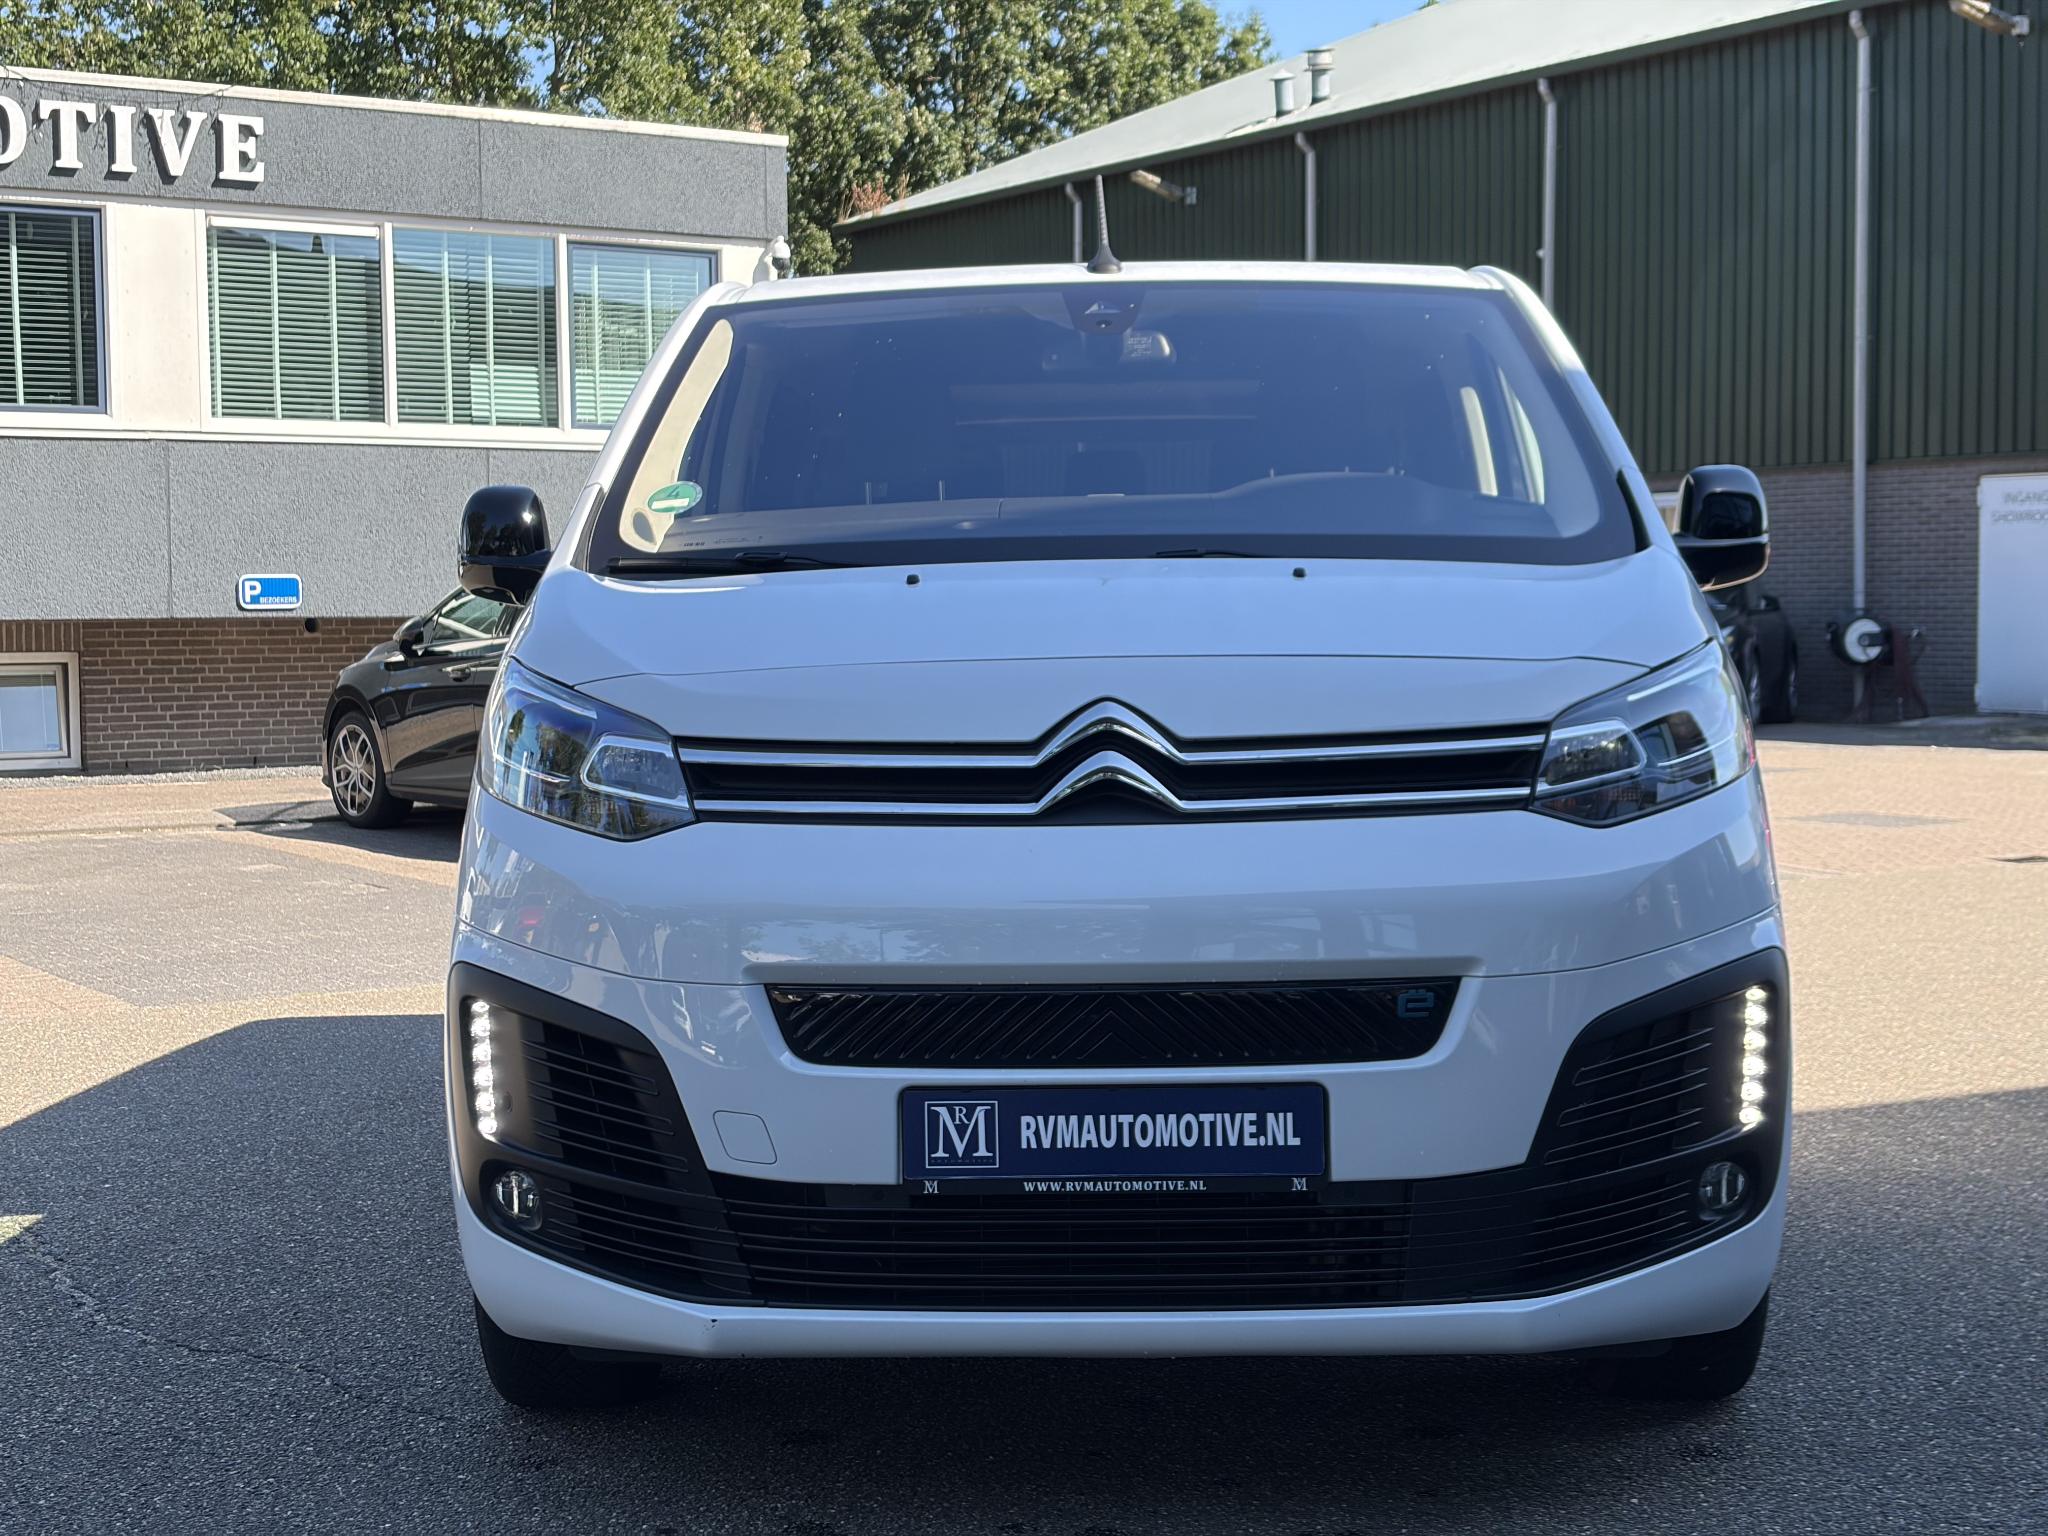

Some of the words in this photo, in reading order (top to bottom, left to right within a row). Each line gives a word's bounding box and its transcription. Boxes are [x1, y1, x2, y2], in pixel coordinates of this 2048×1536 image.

[244, 580, 262, 603] P
[260, 596, 297, 604] BEZOEKERS
[1020, 1112, 1301, 1149] RVMAUTOMOTIVE.NL
[1023, 1180, 1207, 1192] WWW.RVMAUTOMOTIVE.NL
